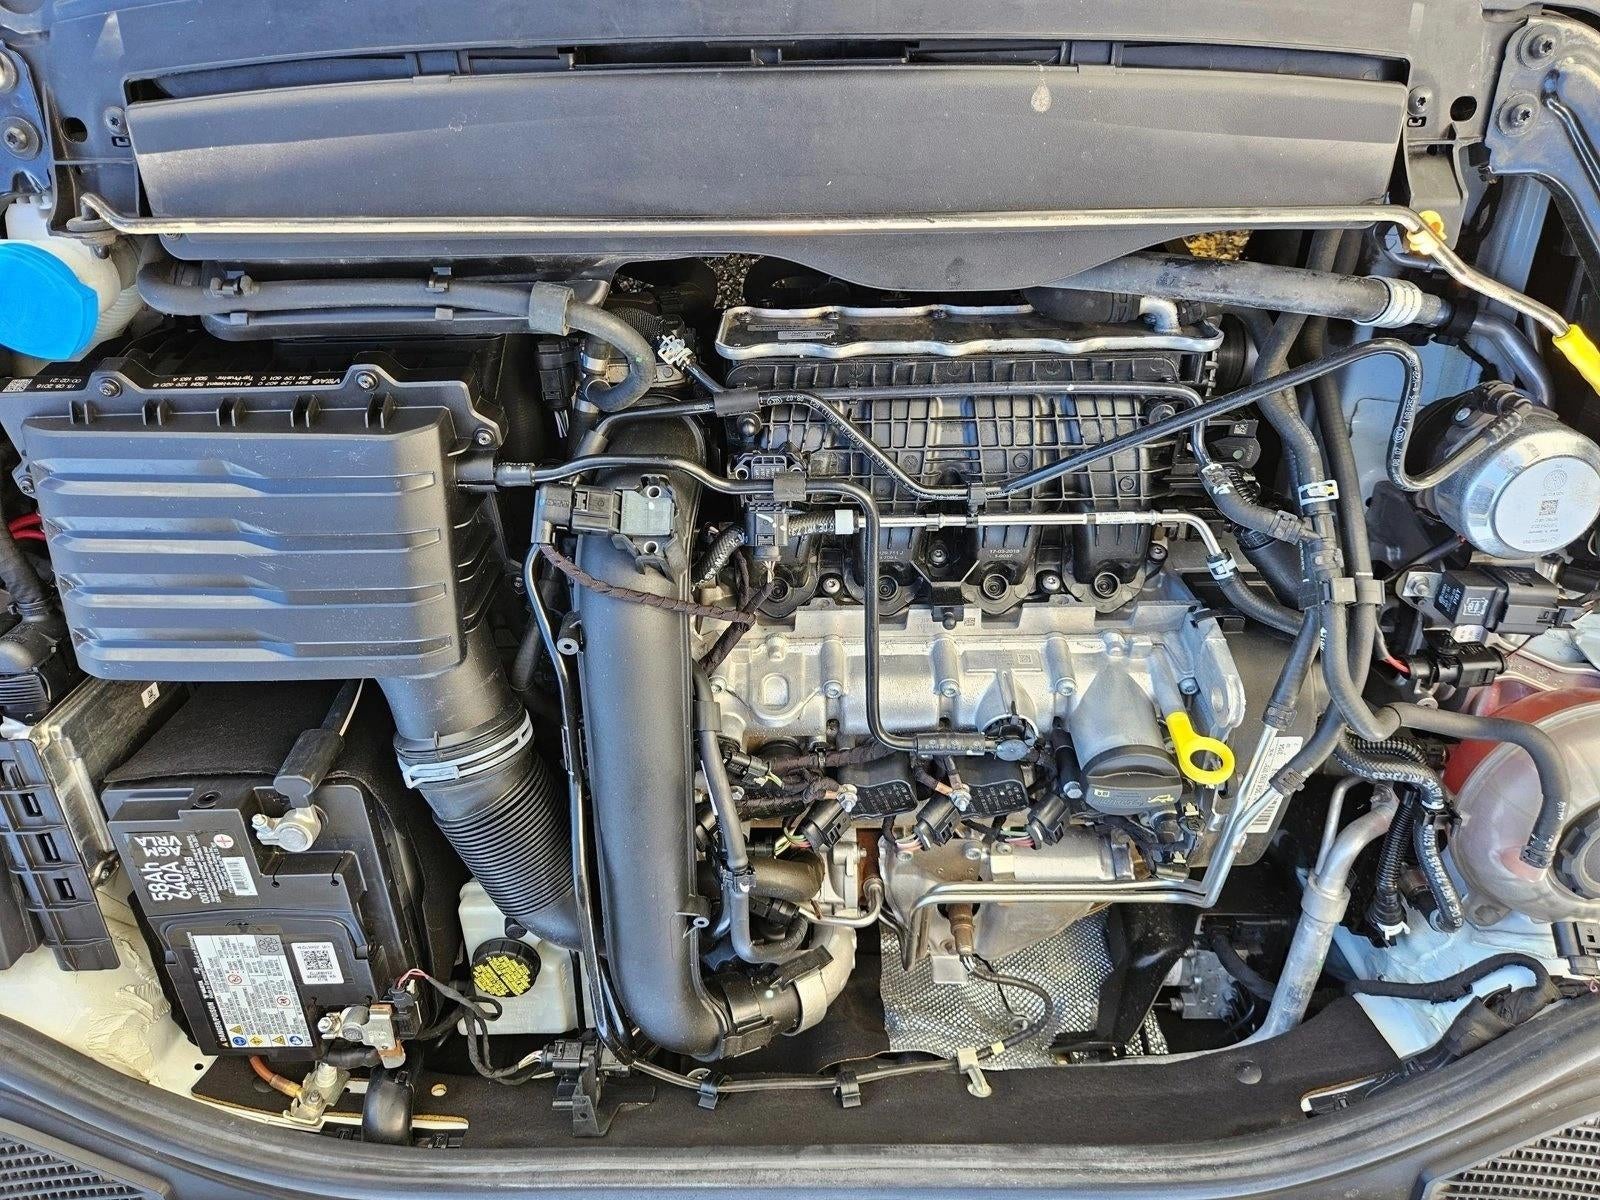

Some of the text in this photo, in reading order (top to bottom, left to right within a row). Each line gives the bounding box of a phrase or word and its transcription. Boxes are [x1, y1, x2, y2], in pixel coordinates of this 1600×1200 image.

[134, 834, 182, 846] VRLA
[143, 846, 181, 857] AGM
[140, 861, 173, 902] 58Ah
[159, 861, 192, 900] 640A
